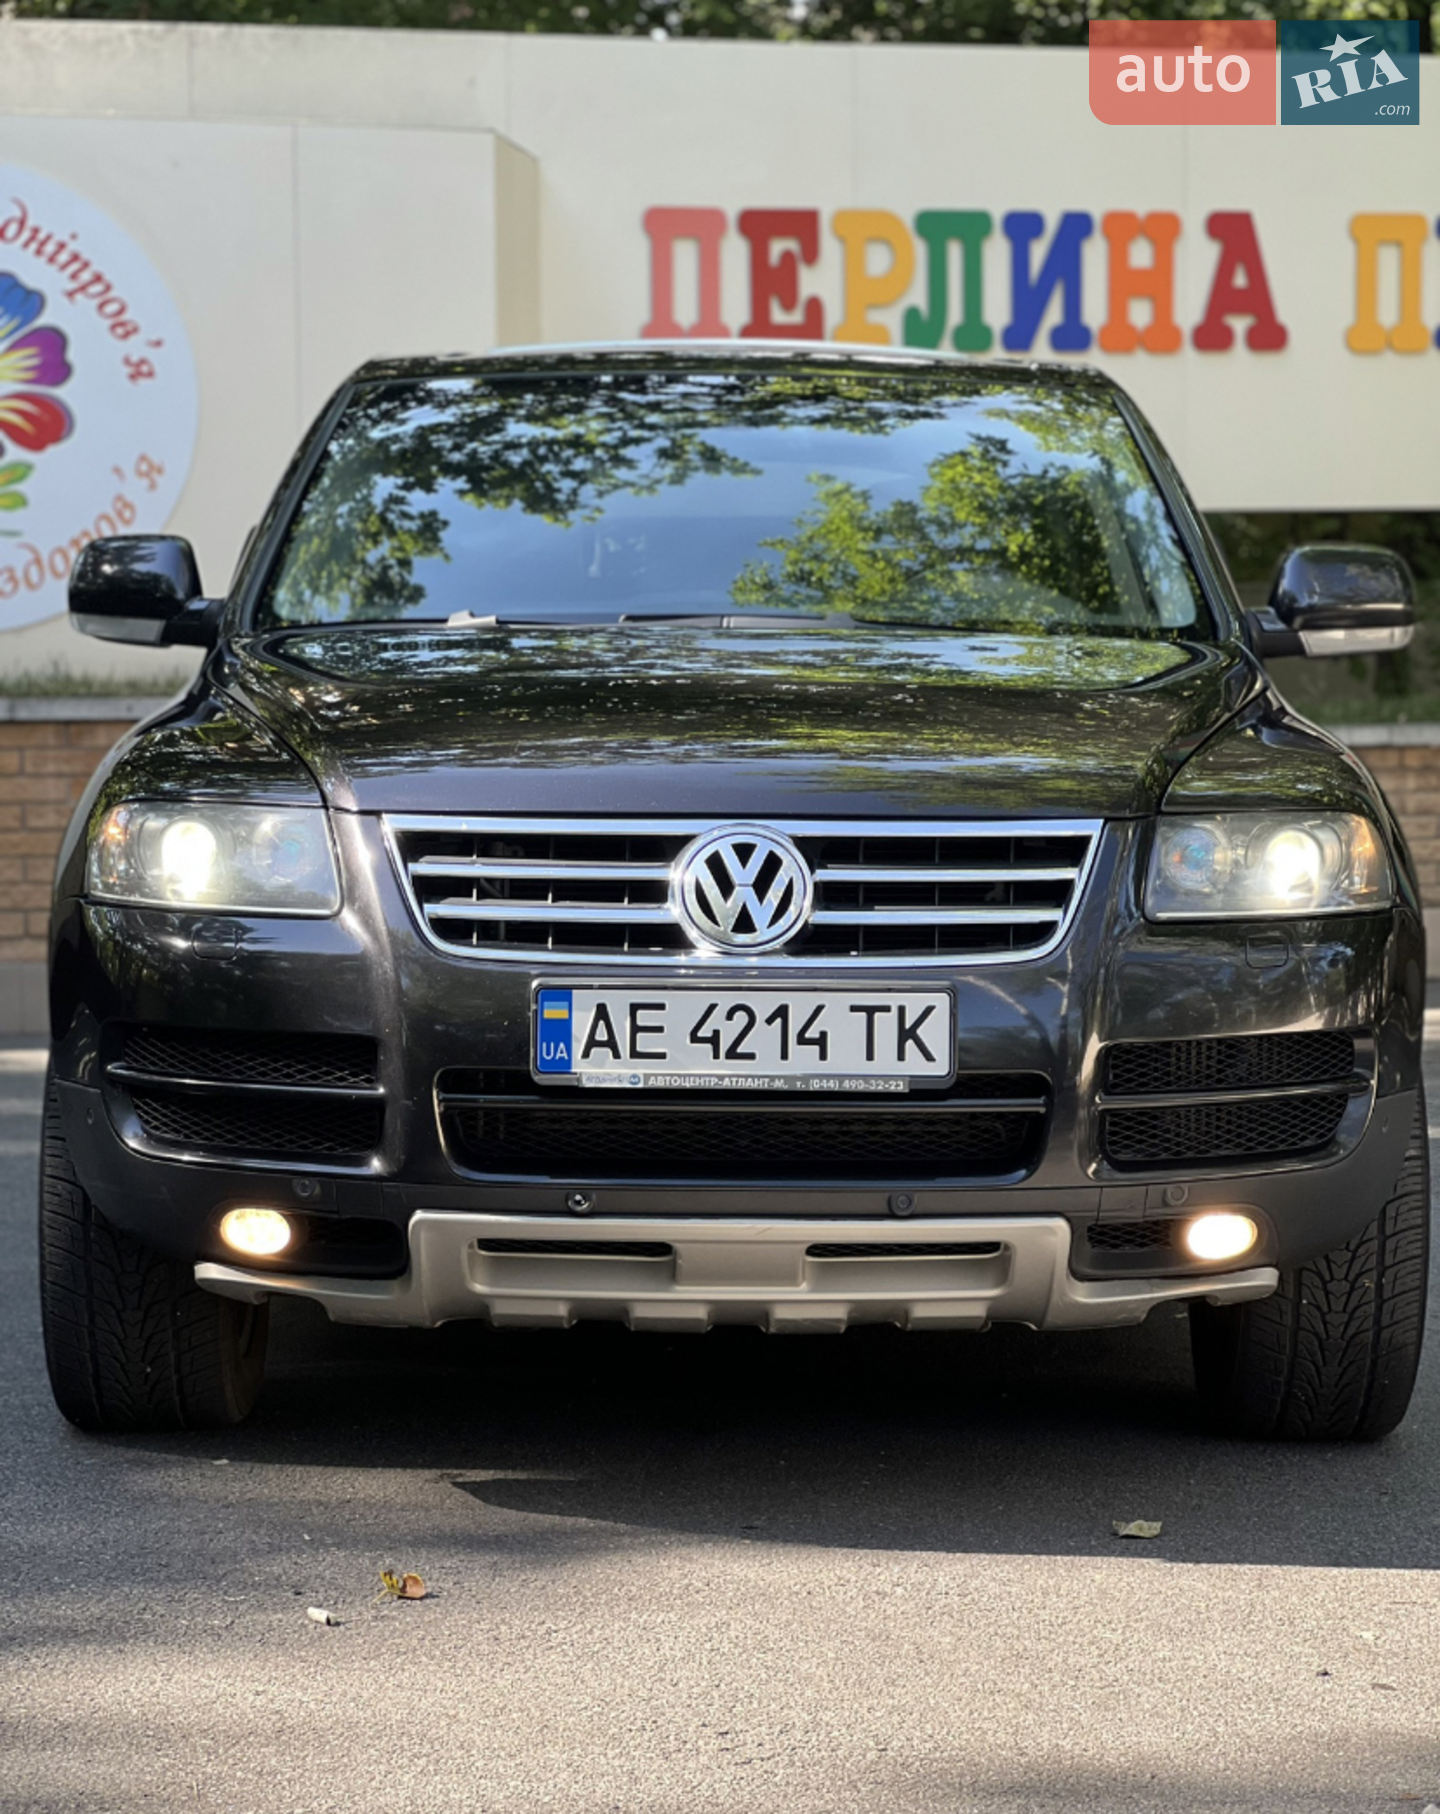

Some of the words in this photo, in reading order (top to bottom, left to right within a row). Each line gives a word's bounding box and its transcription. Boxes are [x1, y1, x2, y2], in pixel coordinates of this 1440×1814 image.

[640, 206, 1289, 354] ПЕРЛИНА
[1345, 211, 1440, 355] П
[541, 1040, 569, 1061] UA
[579, 1002, 668, 1060] AE
[688, 1002, 829, 1062] 4214
[848, 1003, 938, 1063] TK
[809, 1079, 840, 1091] (044)
